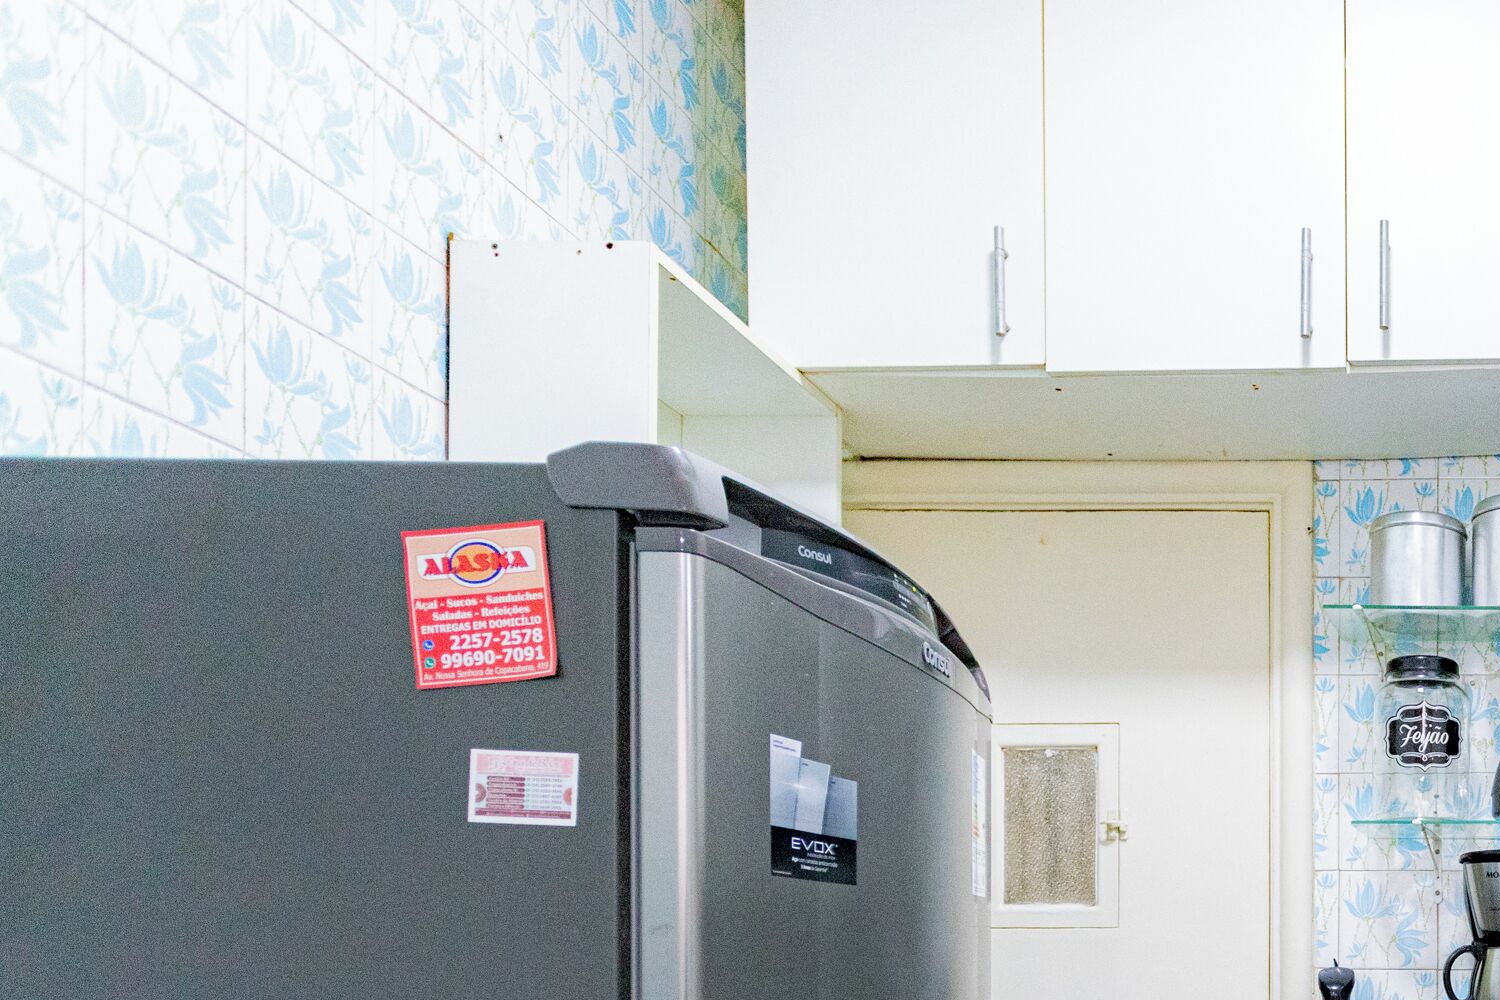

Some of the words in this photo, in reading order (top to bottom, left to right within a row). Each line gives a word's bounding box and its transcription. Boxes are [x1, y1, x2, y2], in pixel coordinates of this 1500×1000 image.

[424, 551, 529, 576] ALASKA
[798, 545, 832, 565] Consul
[432, 610, 473, 621] Saladas
[481, 605, 531, 618] Refeições
[446, 598, 478, 608] Sucos
[421, 622, 472, 635] ENTREGAS
[473, 620, 488, 630] EM
[489, 615, 542, 629] DOMICÍLIO
[450, 628, 544, 650] 2257-2578
[441, 646, 545, 669] 99690-7091
[1400, 724, 1449, 753] Feijão
[791, 837, 836, 855] EVOX
